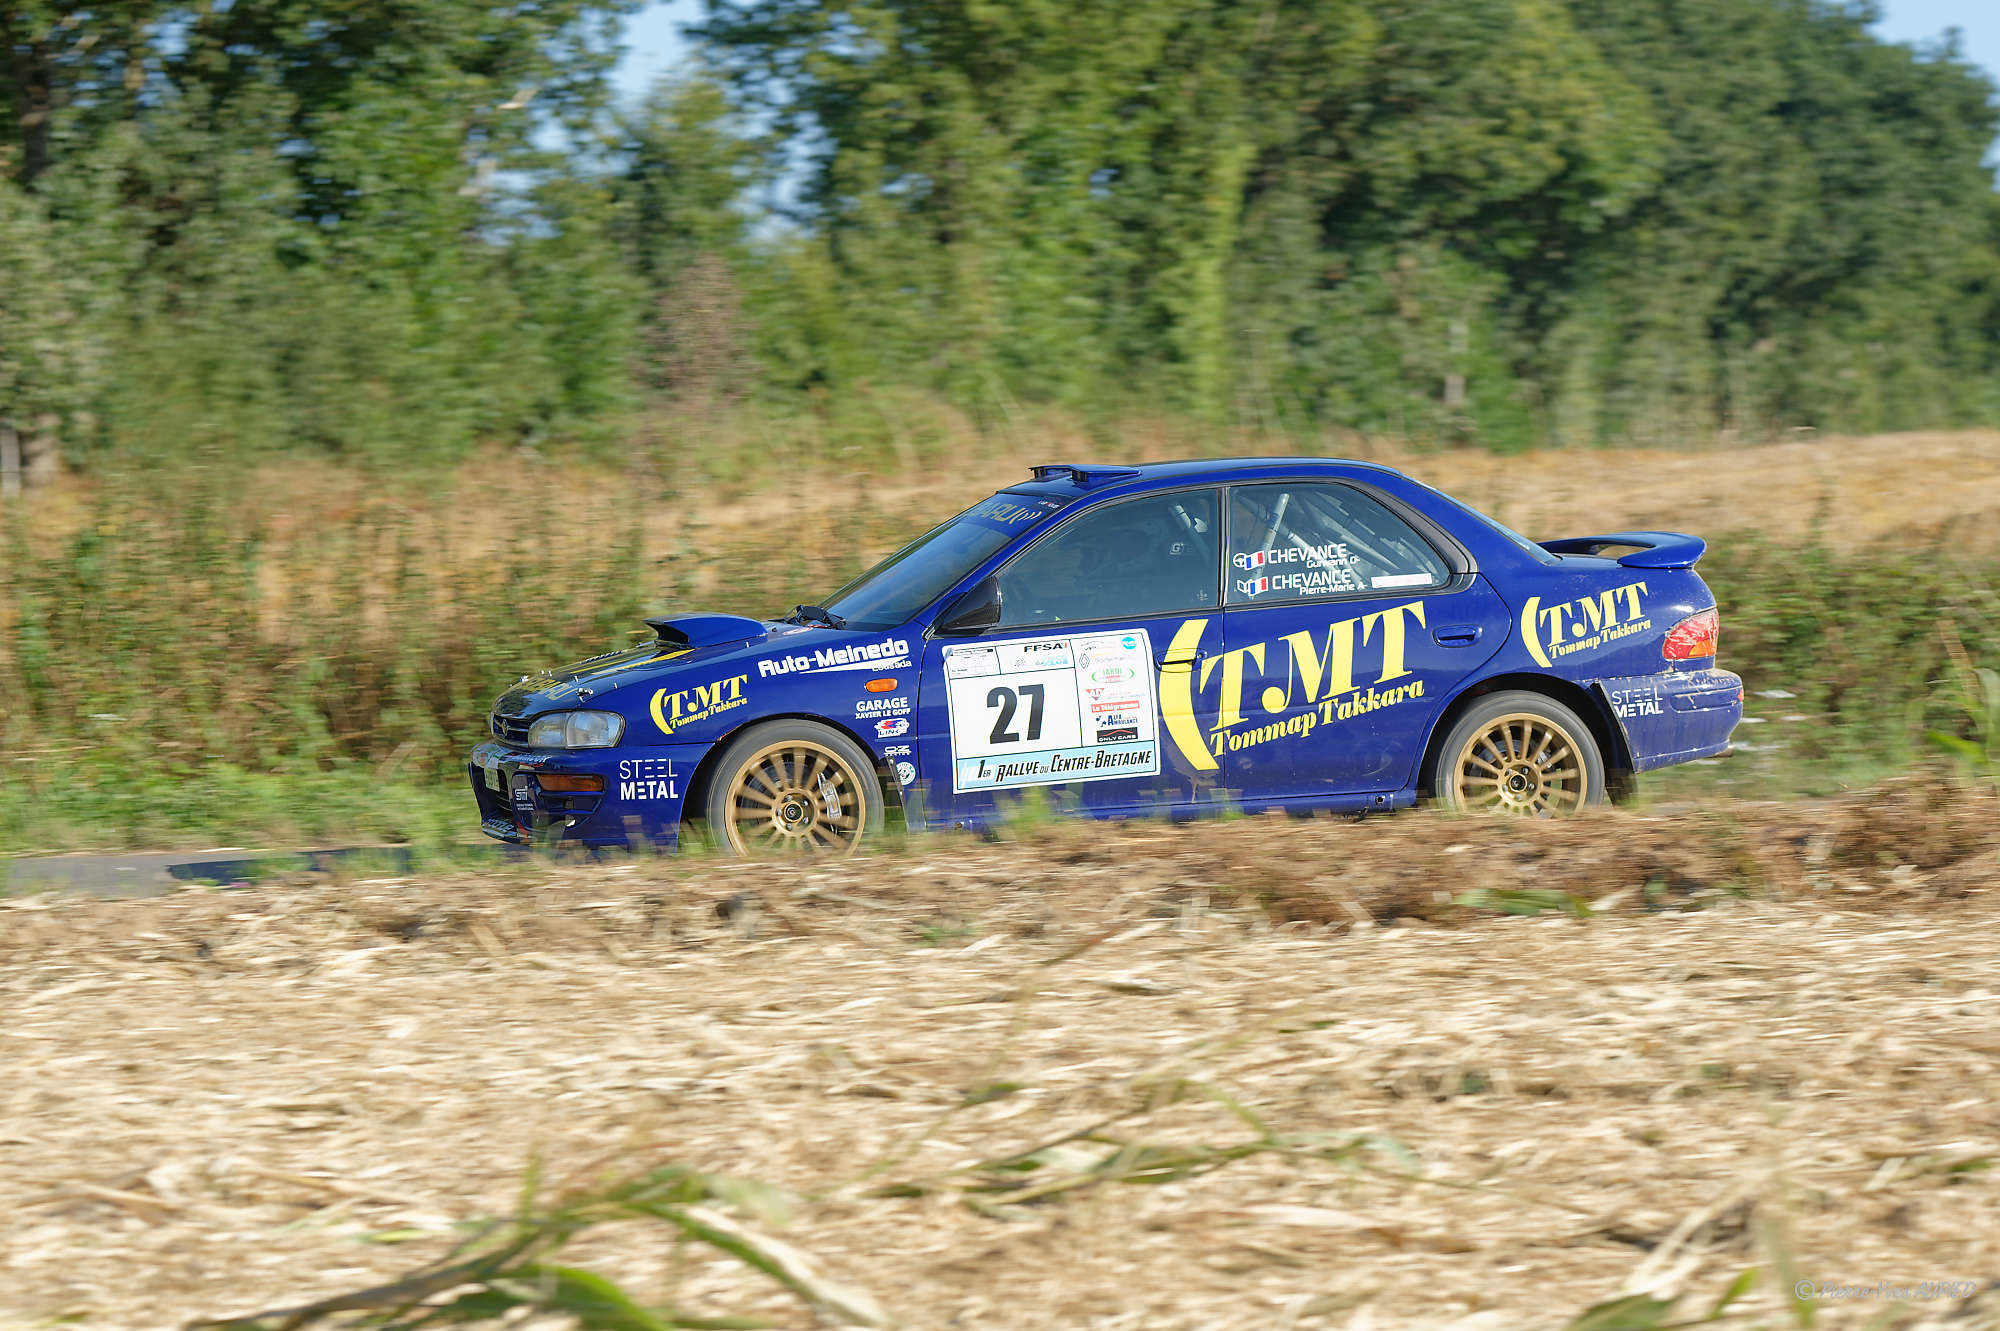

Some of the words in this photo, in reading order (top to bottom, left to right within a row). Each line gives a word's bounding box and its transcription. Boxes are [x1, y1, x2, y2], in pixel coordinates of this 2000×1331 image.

[1268, 544, 1347, 564] CHEVANCE
[1272, 569, 1351, 590] CHEVANCE
[1299, 583, 1355, 596] Pierre-Marie
[1023, 642, 1063, 652] FFSA
[1548, 635, 1601, 659] Tommap
[1600, 619, 1651, 643] Takkara
[757, 637, 910, 678] Auto-Meinedo
[856, 696, 909, 712] GARAGE
[1611, 687, 1664, 705] STEEL
[669, 710, 709, 729] Tommap
[708, 697, 748, 717] Takkara
[855, 711, 882, 720] XAVIER
[882, 709, 892, 717] LE
[892, 707, 911, 716] GOFF
[986, 683, 1045, 745] 27
[1209, 712, 1317, 758] Tommap
[1318, 679, 1425, 727] Takkara
[1613, 701, 1665, 718] METAL
[619, 758, 678, 780] STEEL
[995, 760, 1039, 783] RALLYE
[1049, 749, 1153, 774] CENTRE-BRETAGNE
[620, 780, 679, 801] METAL
